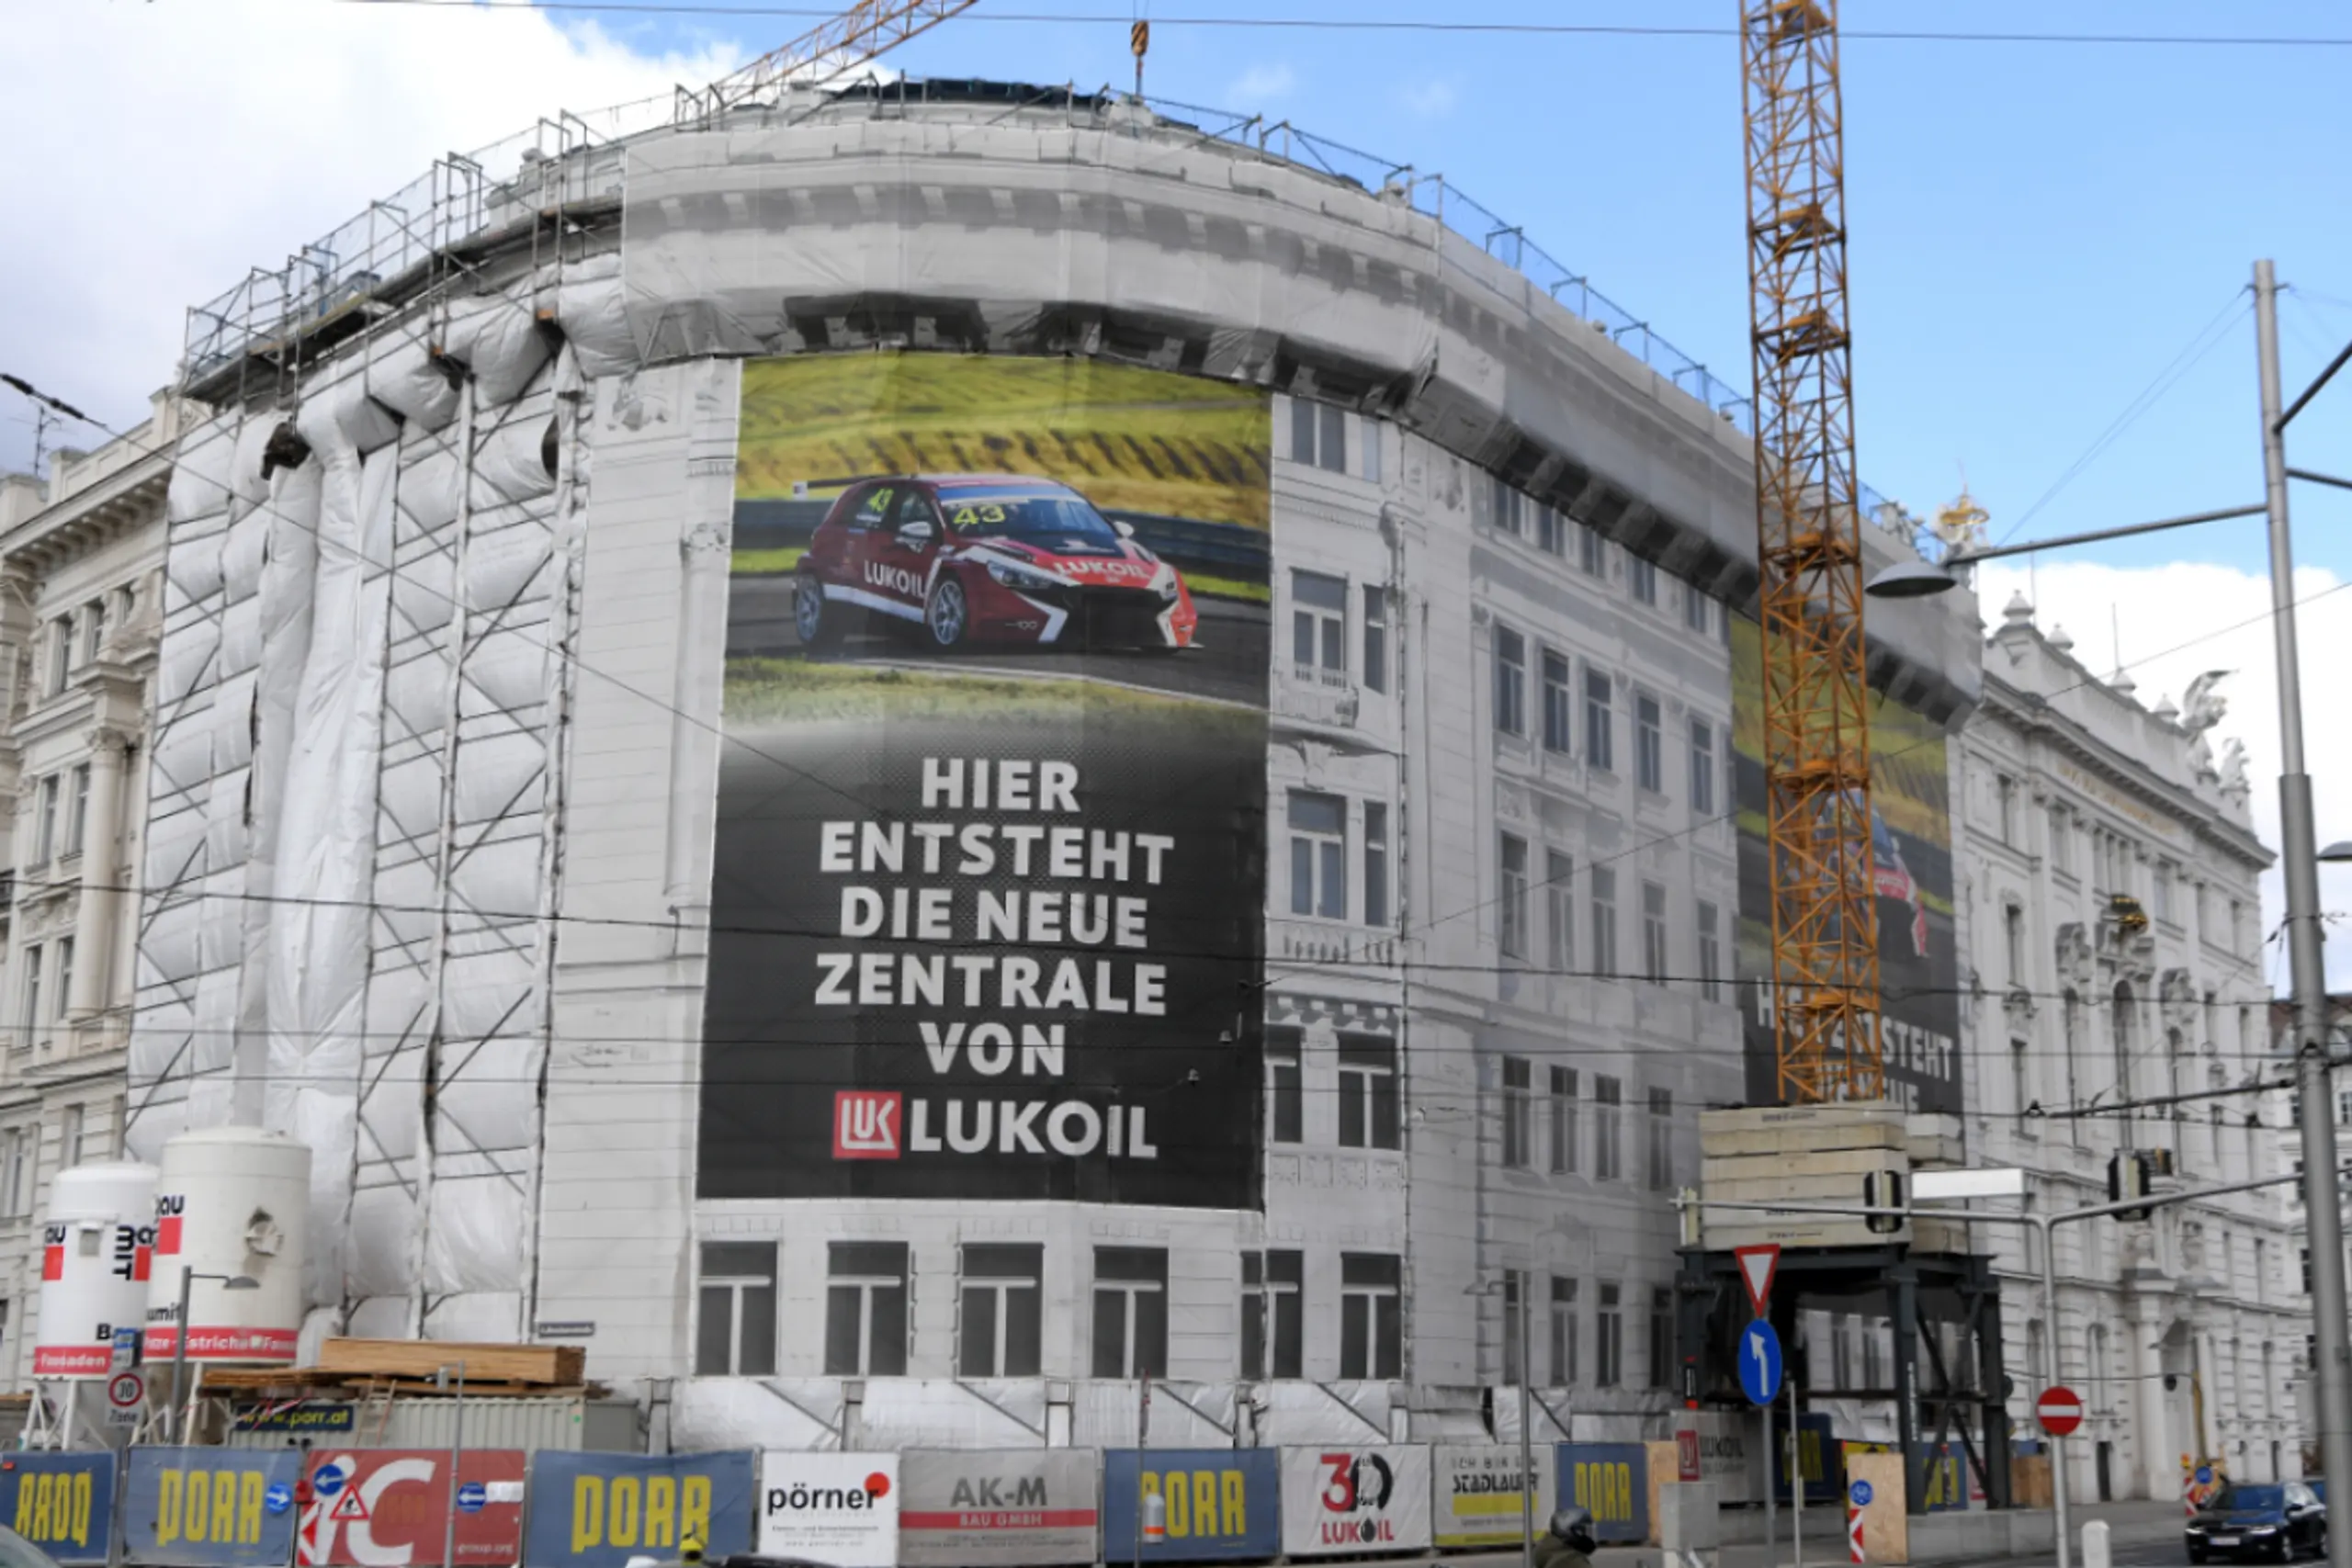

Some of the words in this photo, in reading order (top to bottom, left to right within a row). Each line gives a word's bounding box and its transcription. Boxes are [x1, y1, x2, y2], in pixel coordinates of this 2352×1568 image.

[953, 505, 1006, 525] 43
[864, 559, 928, 597] LUKOIL
[1054, 560, 1150, 580] LUKOIL
[922, 758, 1080, 812] HIER
[820, 821, 1174, 885] ENTSTEHT
[840, 886, 953, 940] DIE
[976, 890, 1148, 948] NEUE
[815, 953, 1167, 1015] ZENTRALE
[919, 1021, 1066, 1076] VON
[909, 1100, 1159, 1158] LUKOIL
[156, 1468, 265, 1548] PORR
[767, 1481, 880, 1517] pörner
[950, 1476, 1048, 1507] AK-M
[1320, 1451, 1395, 1513] 30
[571, 1474, 712, 1554] PORR
[958, 1512, 991, 1527] BAU
